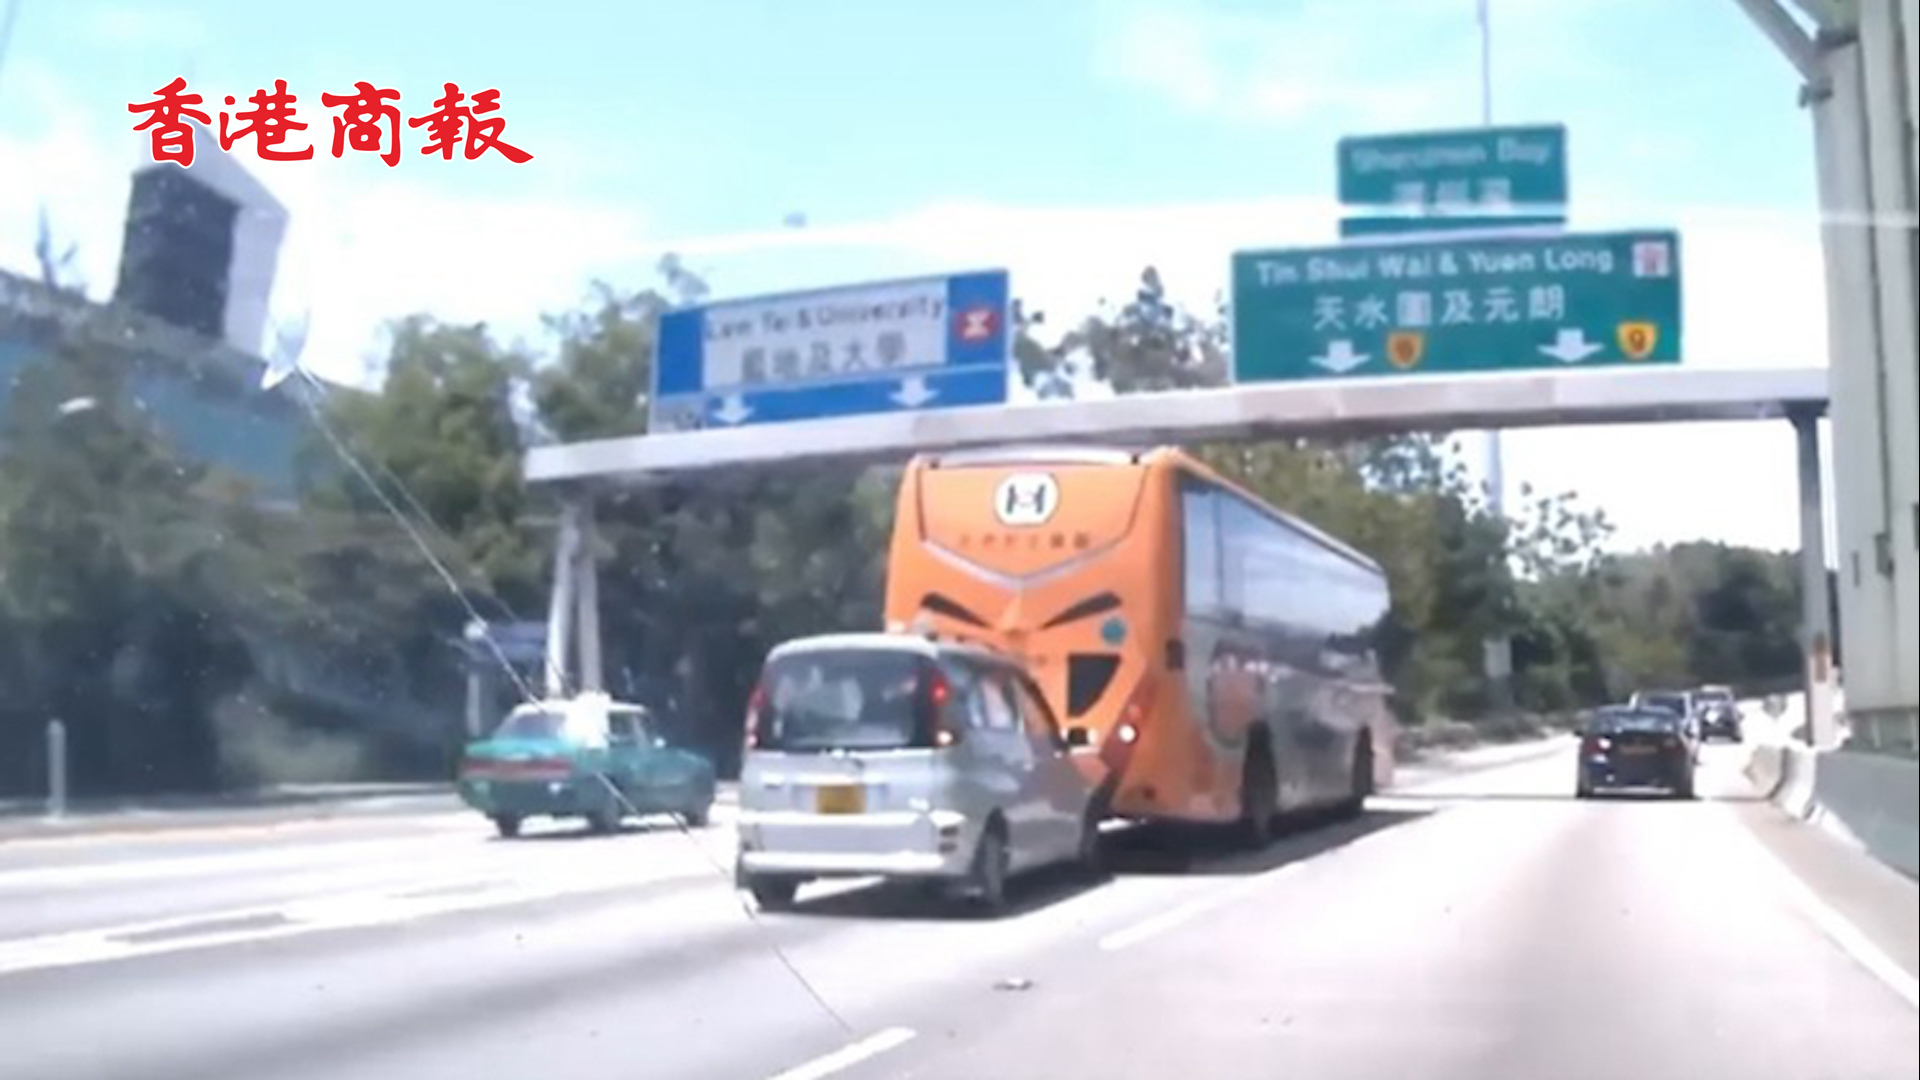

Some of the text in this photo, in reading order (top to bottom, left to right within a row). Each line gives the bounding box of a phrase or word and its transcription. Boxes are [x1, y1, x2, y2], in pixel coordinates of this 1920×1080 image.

[1257, 246, 1615, 286] Tin Shui Wai & Yuen Long
